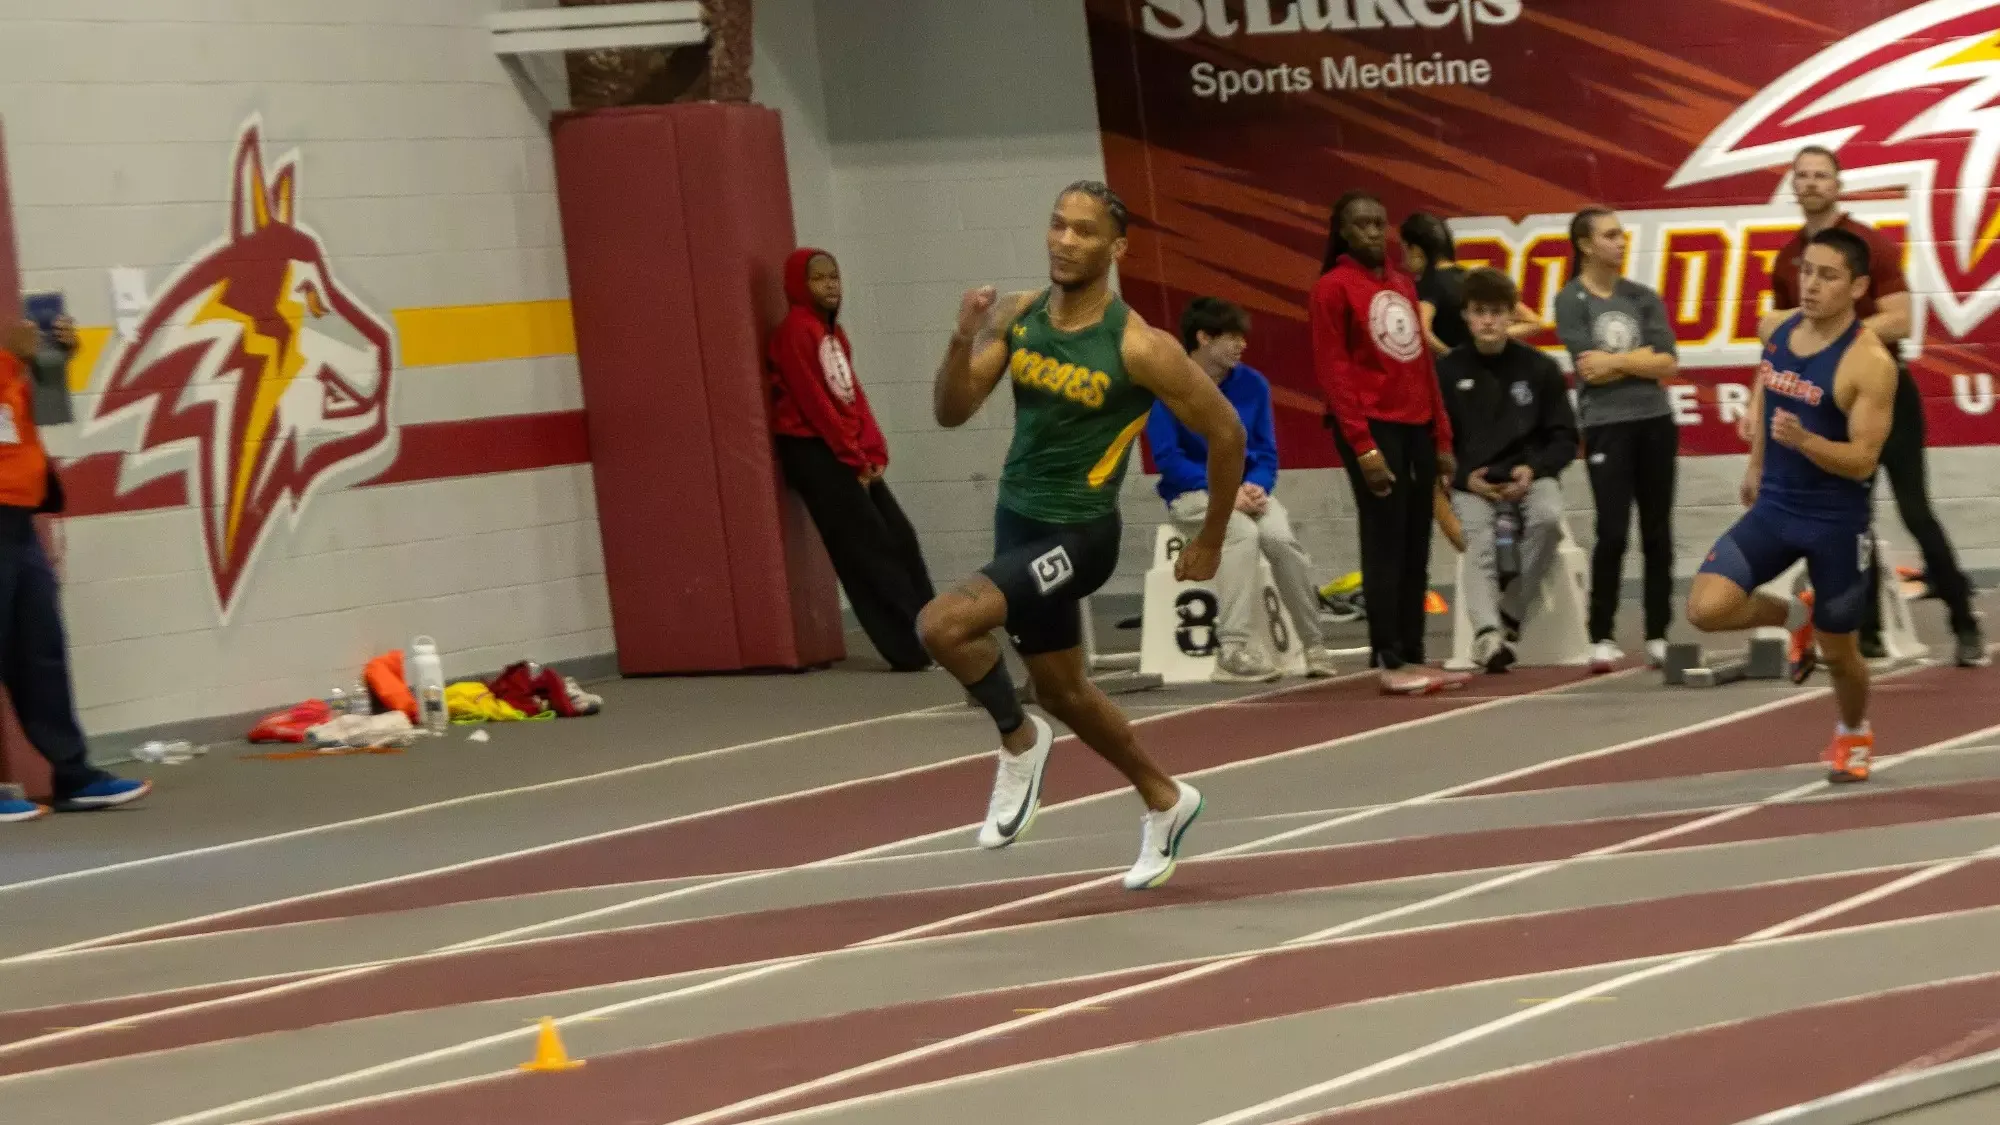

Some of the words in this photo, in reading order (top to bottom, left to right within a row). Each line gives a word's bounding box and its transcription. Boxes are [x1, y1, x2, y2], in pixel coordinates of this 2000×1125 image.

[1190, 62, 1314, 103] Sports
[1320, 52, 1492, 91] Medicine
[1037, 552, 1070, 583] 5
